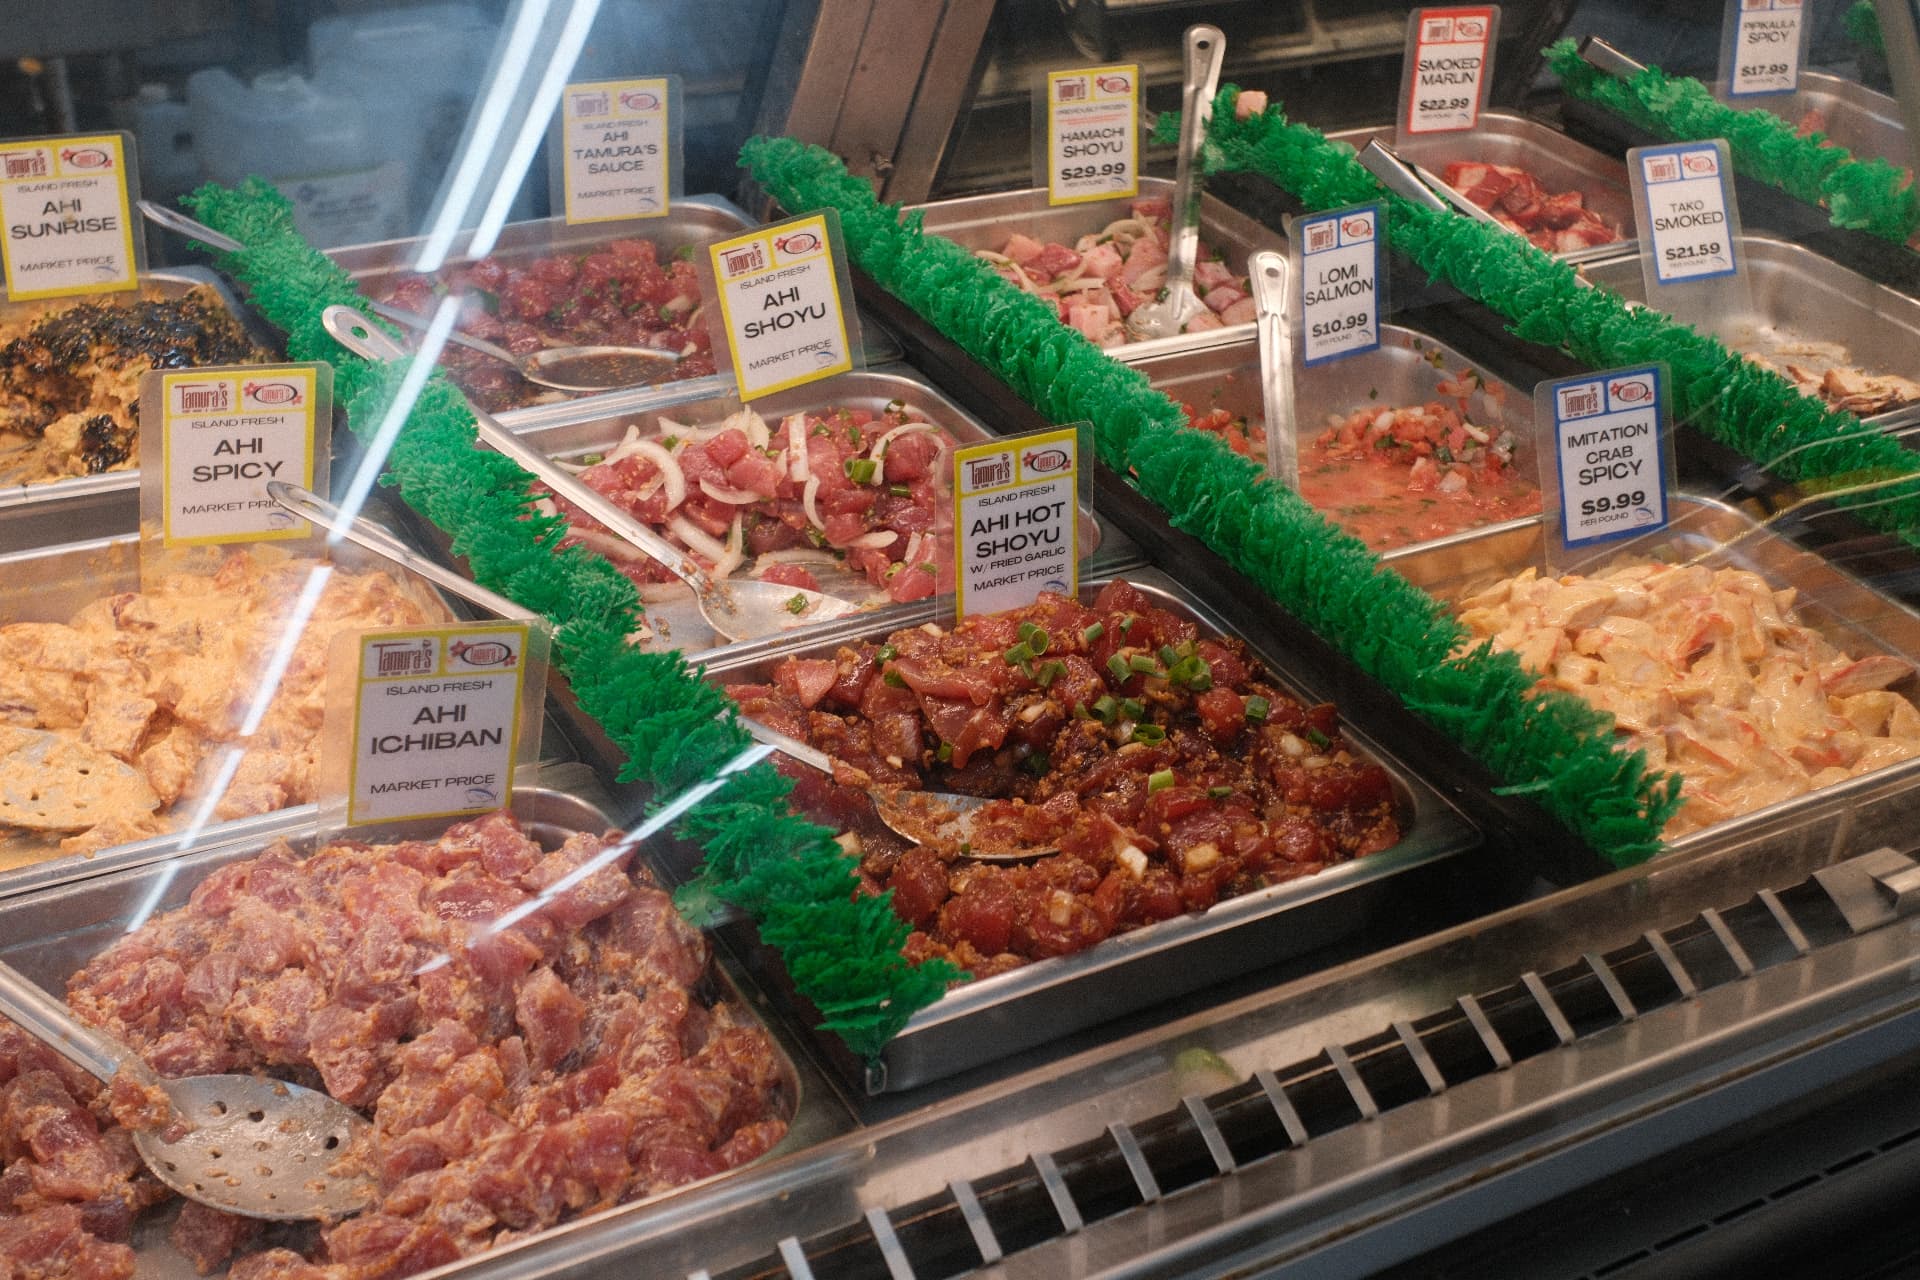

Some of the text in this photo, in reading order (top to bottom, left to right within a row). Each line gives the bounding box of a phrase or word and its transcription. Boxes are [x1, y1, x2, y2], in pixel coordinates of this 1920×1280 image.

[1748, 31, 1789, 44] SPICY
[1418, 57, 1481, 72] SMOKED
[1741, 63, 1789, 77] $17.99
[1421, 72, 1475, 85] MARLIN
[1419, 97, 1469, 112] $22.99
[602, 131, 629, 142] AHI
[1061, 128, 1124, 142] HAMACHI
[574, 144, 658, 159] TAMURA'S
[1063, 141, 1124, 158] SHOYU
[588, 160, 644, 174] SAUCE
[1061, 162, 1125, 180] $29.99
[17, 179, 98, 193] ISLAND FRESH
[42, 199, 82, 215] AHI
[1669, 200, 1705, 213] TAKO
[11, 217, 117, 239] SUNRISE
[1655, 211, 1724, 231] SMOKED
[1666, 242, 1721, 261] $21.59
[20, 256, 115, 272] MARKET PRICE
[1319, 263, 1358, 285] LOMI
[740, 274, 776, 290] ISLAND
[778, 265, 811, 280] FRESH
[763, 286, 800, 310] AHI
[1305, 278, 1374, 307] SALMON
[744, 302, 826, 339] SHOYU
[1312, 312, 1368, 338] $10.99
[749, 339, 832, 370] MARKET PRICE
[174, 382, 228, 409] Tamura's
[192, 416, 285, 429] ISLAND FRESH
[1567, 423, 1648, 449] IMITATION
[213, 438, 263, 456] AHI
[1586, 445, 1634, 464] CRAB
[192, 461, 284, 482] SPICY
[965, 453, 1010, 485] Tamura's
[1578, 459, 1643, 486] SPICY
[978, 485, 1056, 507] ISLAND FRESH
[1581, 491, 1645, 515] $9.99
[182, 500, 281, 515] MARKET PRIC
[970, 502, 1066, 536] AHI HOT
[1580, 512, 1629, 527] PER POUND
[976, 527, 1060, 558] SHOYU
[970, 547, 1066, 574] W/ FRIED GARLIC
[974, 564, 1065, 592] MARKET PRICE
[372, 639, 432, 672] Tamura's
[386, 680, 493, 696] ISLAND FRESH
[412, 704, 467, 725] AHI
[371, 728, 503, 755] ICHIBAN
[370, 774, 496, 794] MARKET PRICE
